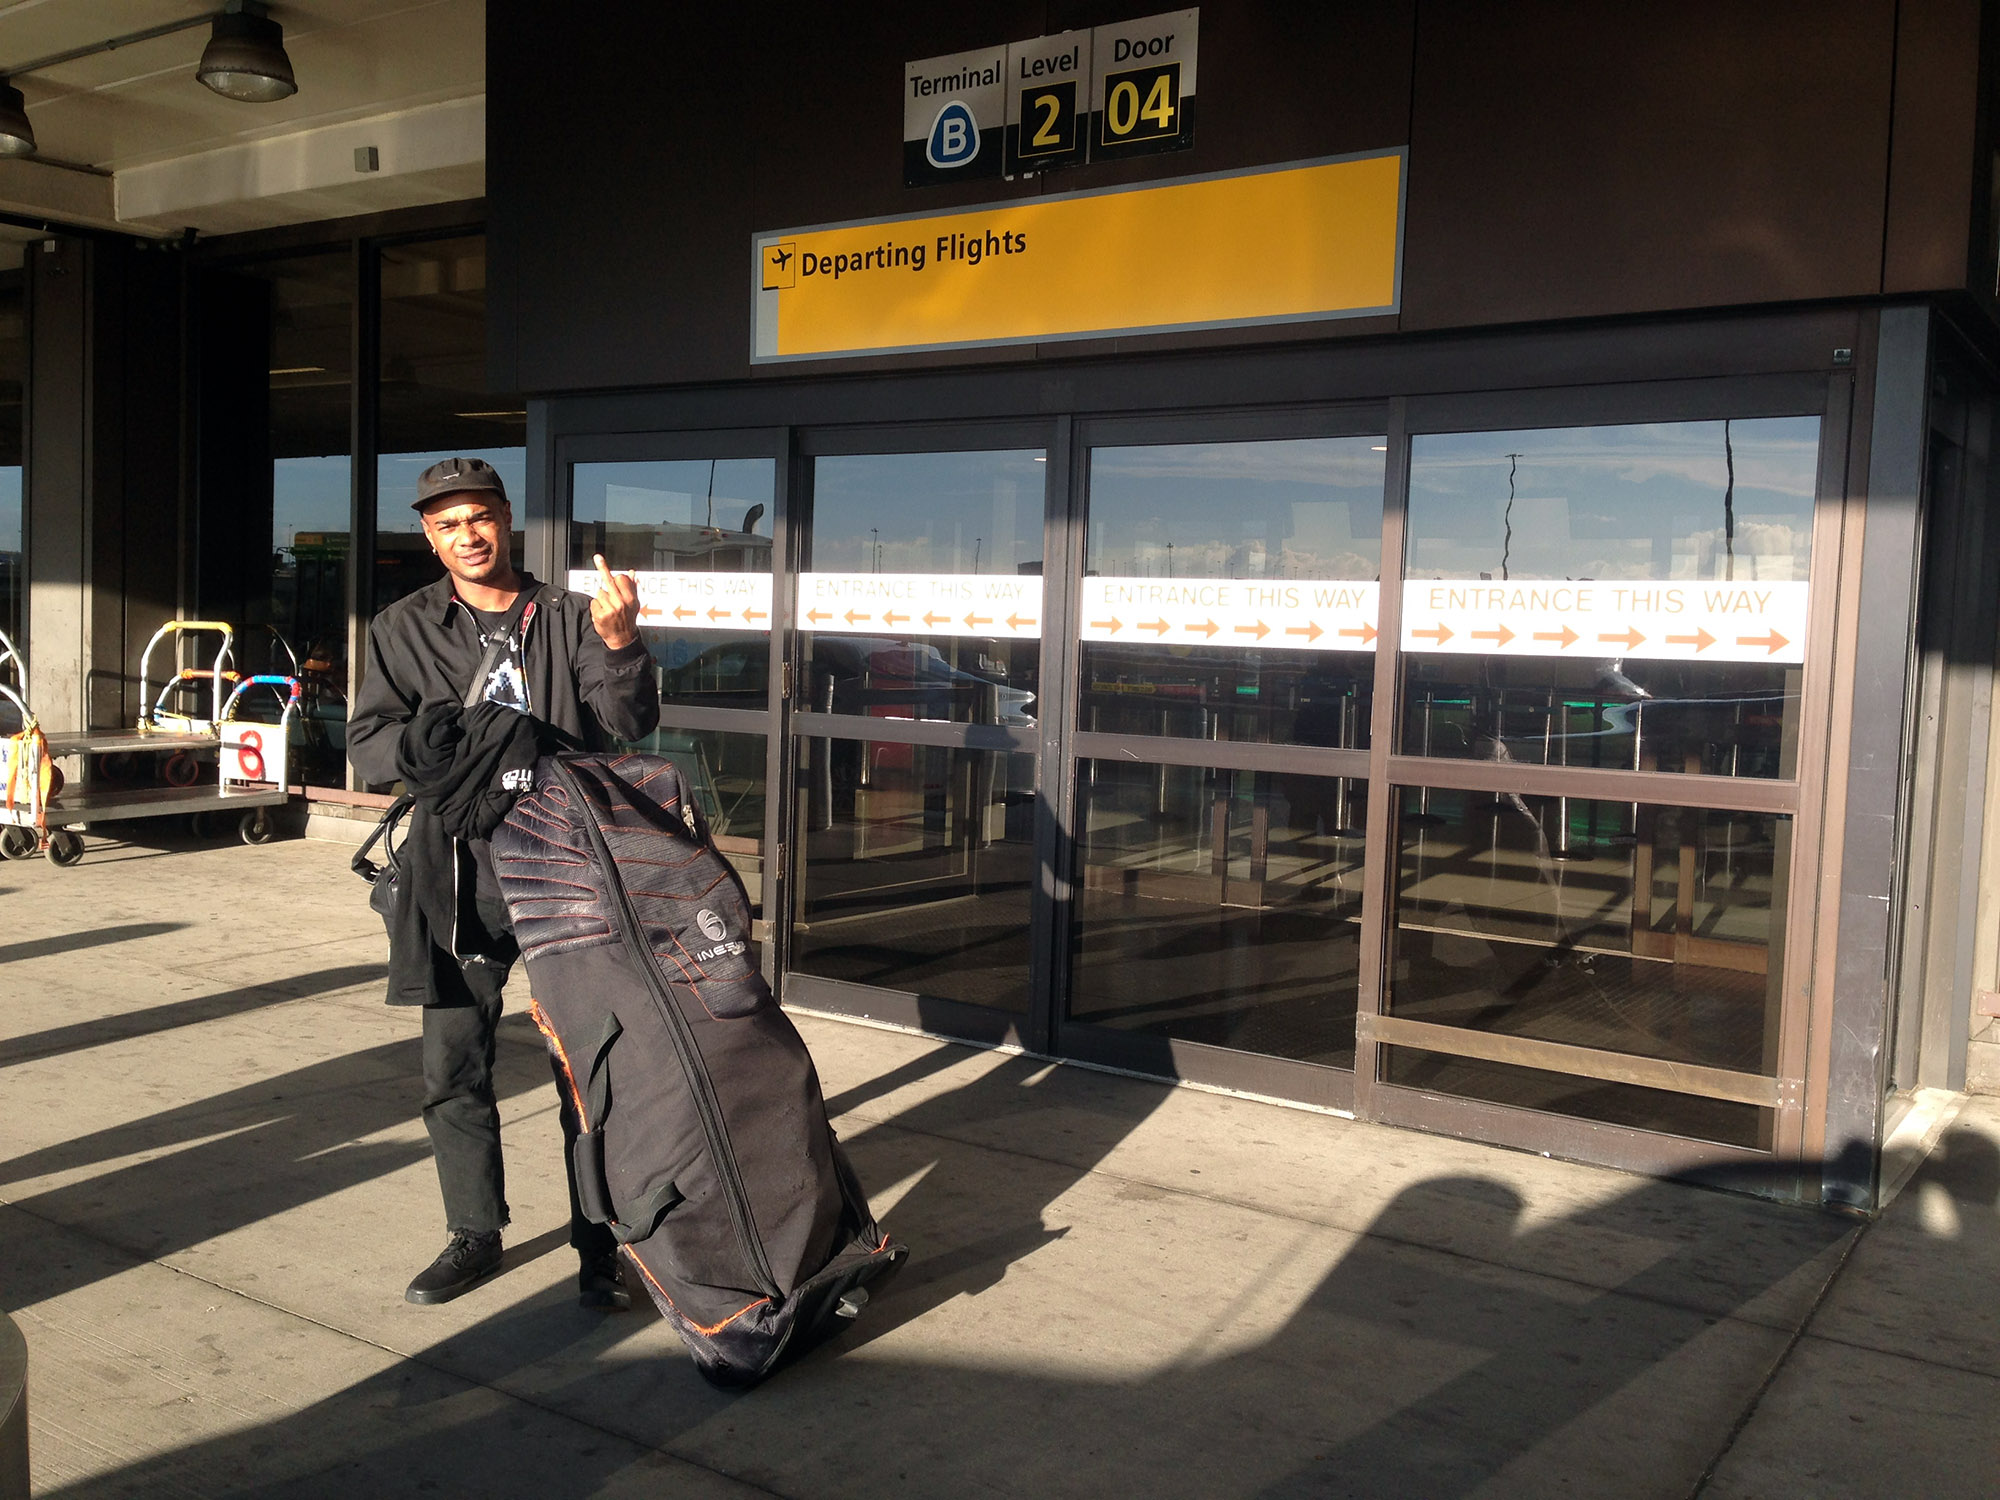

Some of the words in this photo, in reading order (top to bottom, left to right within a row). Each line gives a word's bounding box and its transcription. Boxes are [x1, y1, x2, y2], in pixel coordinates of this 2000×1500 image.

[1020, 46, 1079, 79] Level
[1113, 33, 1175, 62] Door
[909, 61, 1001, 98] Terminal
[1032, 94, 1061, 147] 2
[1108, 74, 1174, 136] 04
[942, 117, 967, 156] B
[802, 242, 926, 279] Departing
[936, 229, 1026, 265] Flights
[678, 577, 714, 596] THIS
[724, 578, 757, 596] WAY
[815, 579, 917, 599] ENTRANCE
[928, 580, 973, 600] THIS
[984, 581, 1025, 600] WAY
[1104, 584, 1231, 607] ENTRANCE
[1244, 586, 1300, 608] THIS
[1313, 587, 1367, 609] WAY
[1429, 587, 1594, 612] ENTRANCE
[1611, 589, 1686, 613] THIS
[1704, 590, 1772, 614] WAY
